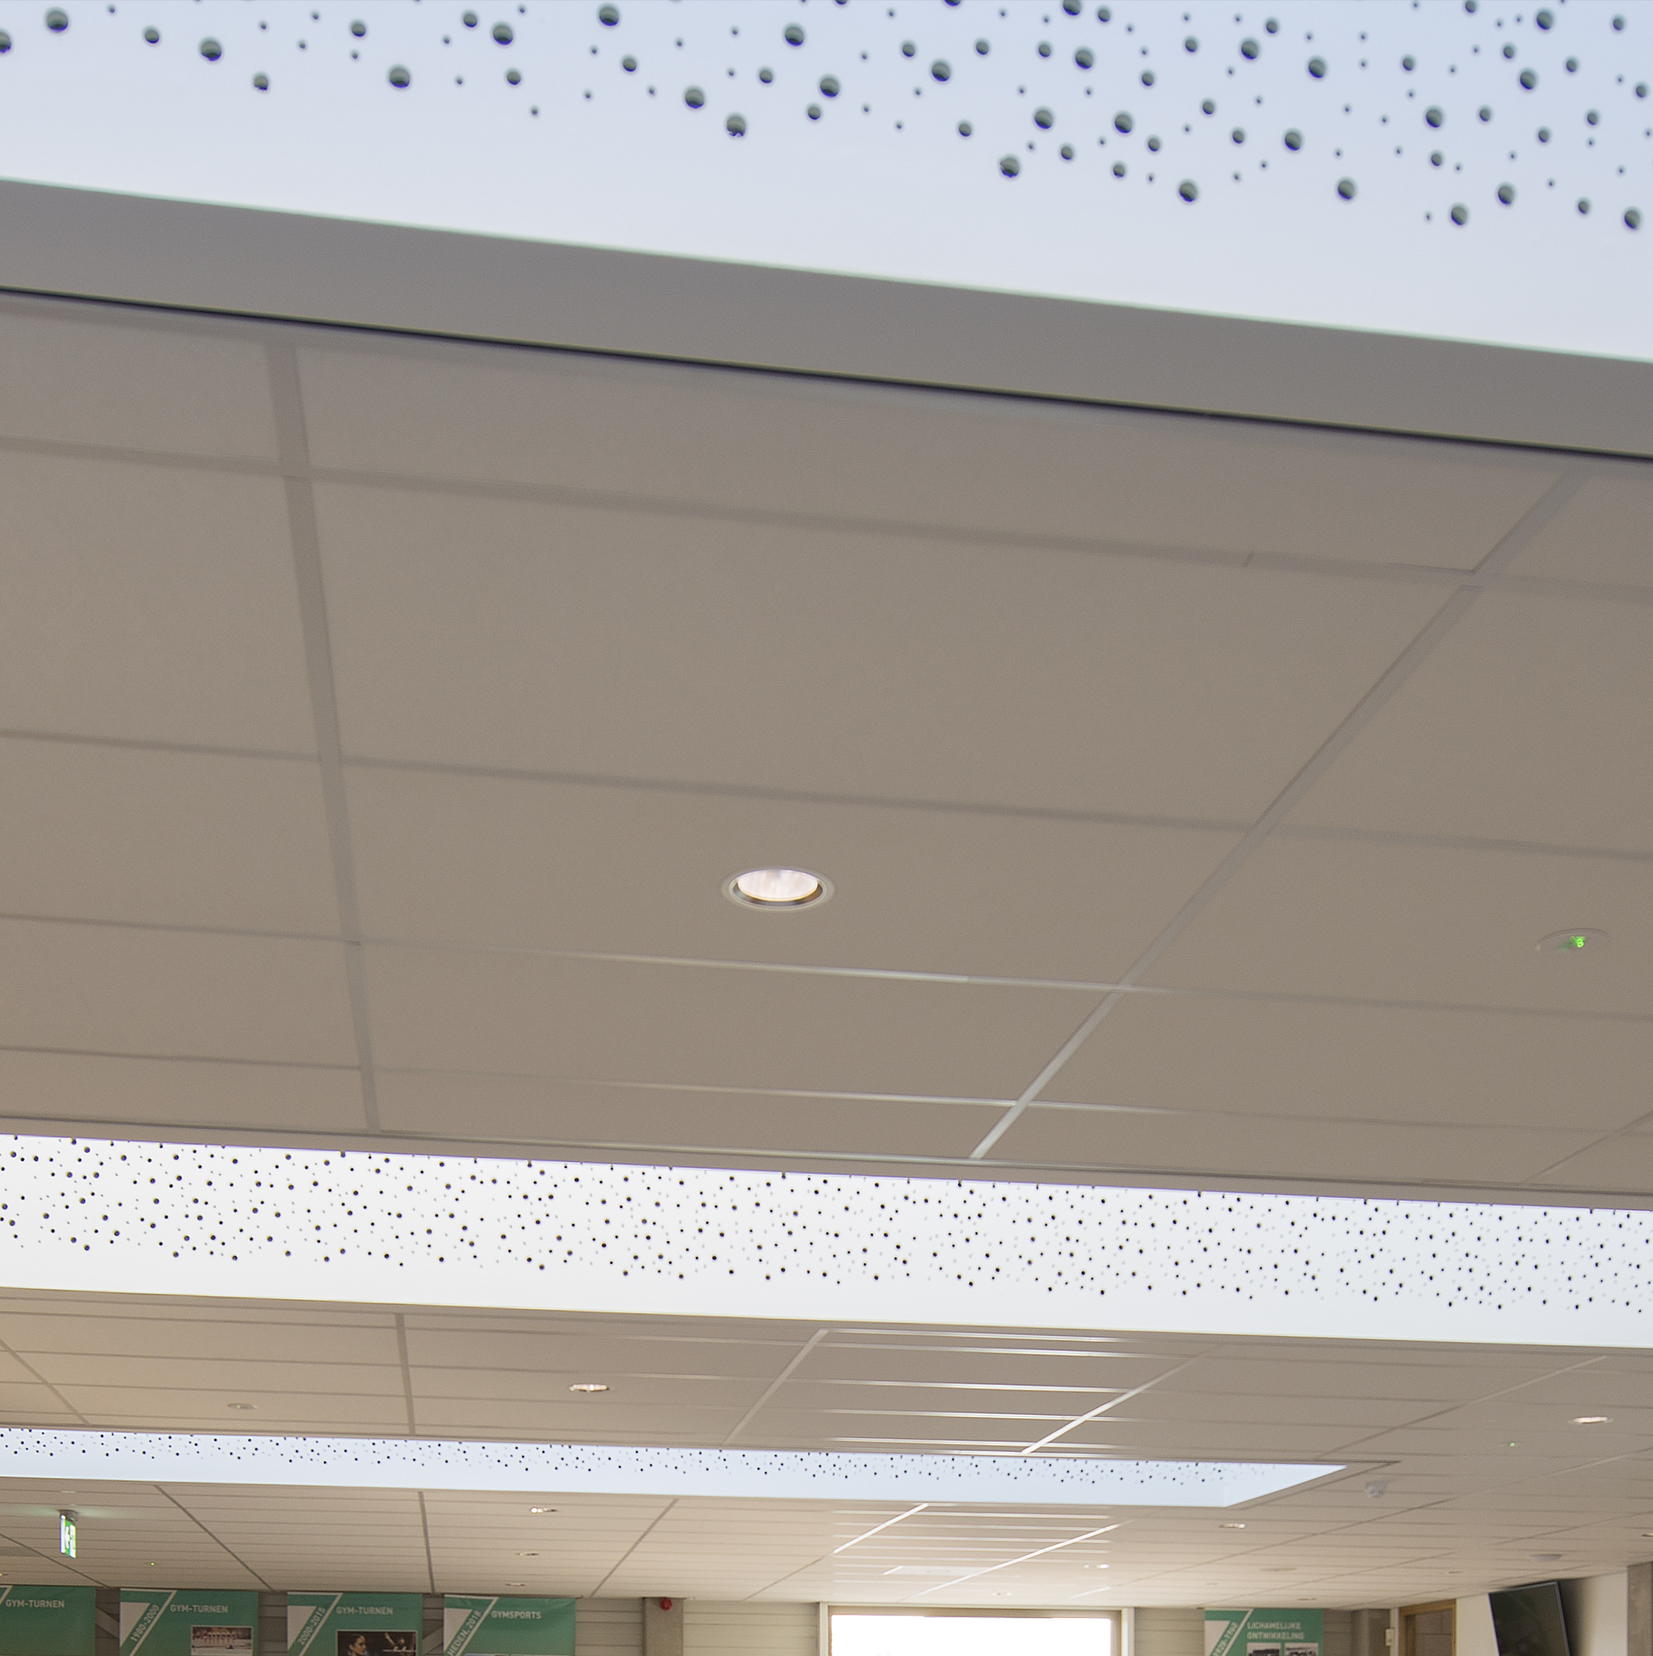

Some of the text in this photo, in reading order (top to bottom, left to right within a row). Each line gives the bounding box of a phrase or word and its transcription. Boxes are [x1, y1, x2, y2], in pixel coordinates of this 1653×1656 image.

[6, 1599, 65, 1608] GYM-TURNEN
[170, 1604, 229, 1613] GYM-TURNEN
[335, 1606, 394, 1615] GYM-TURNEN
[490, 1610, 542, 1619] GYMSPORTS
[130, 1604, 160, 1642] 1980-2000
